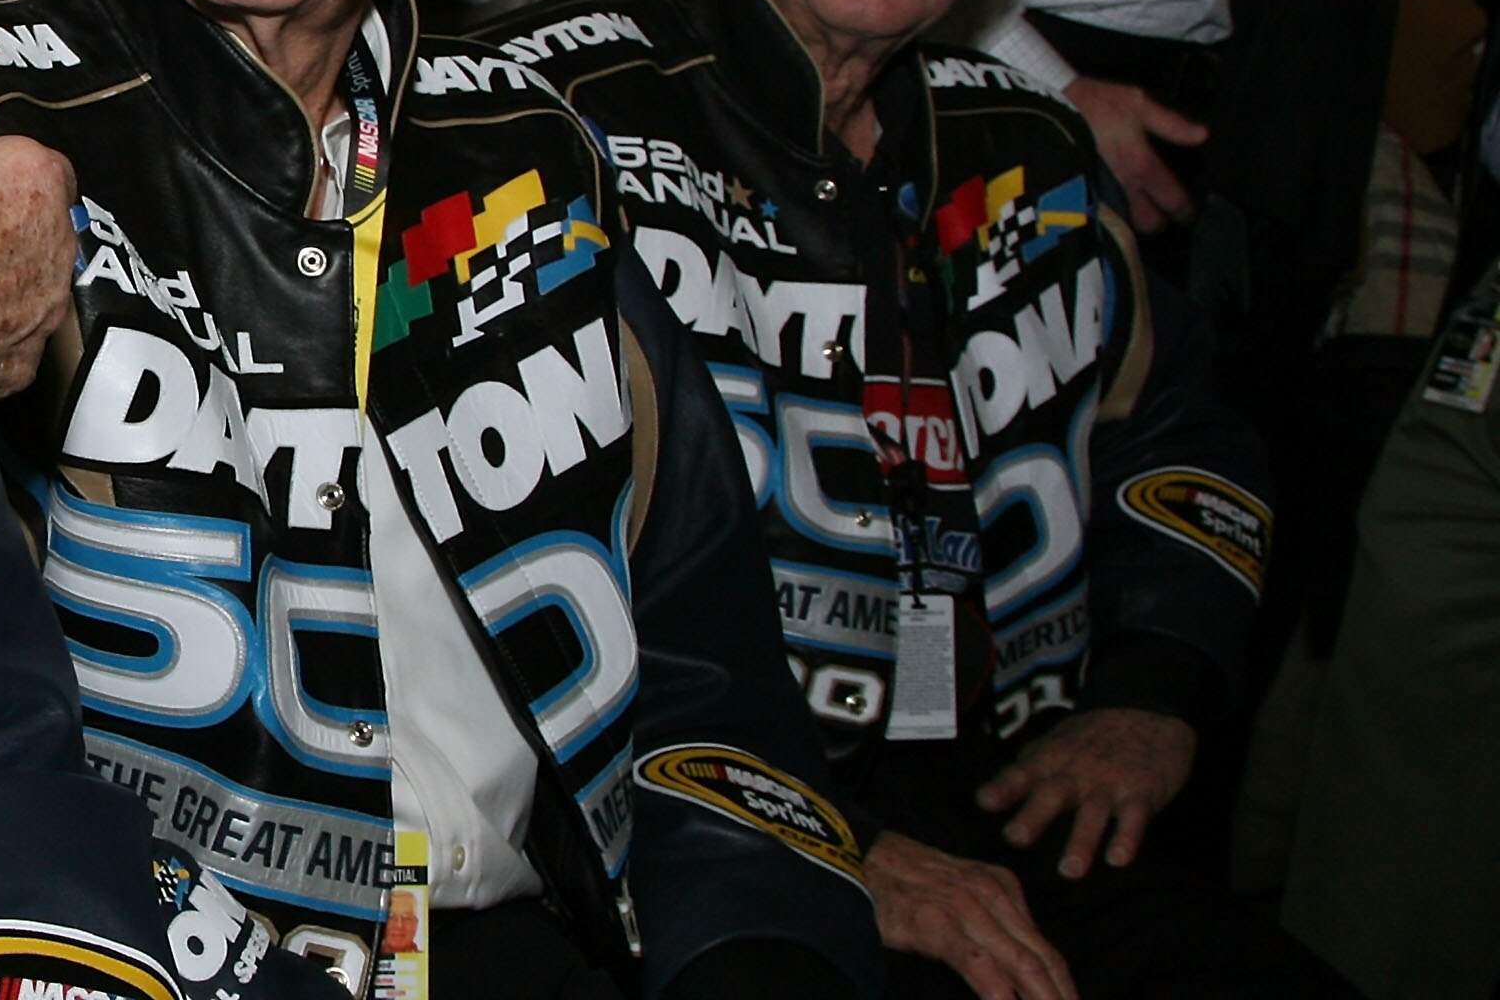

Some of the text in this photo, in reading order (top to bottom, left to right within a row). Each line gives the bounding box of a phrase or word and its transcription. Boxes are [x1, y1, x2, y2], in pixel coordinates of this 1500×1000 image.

[354, 96, 380, 161] NASCAR
[171, 784, 303, 871] GREAT
[741, 788, 830, 839] Sprint
